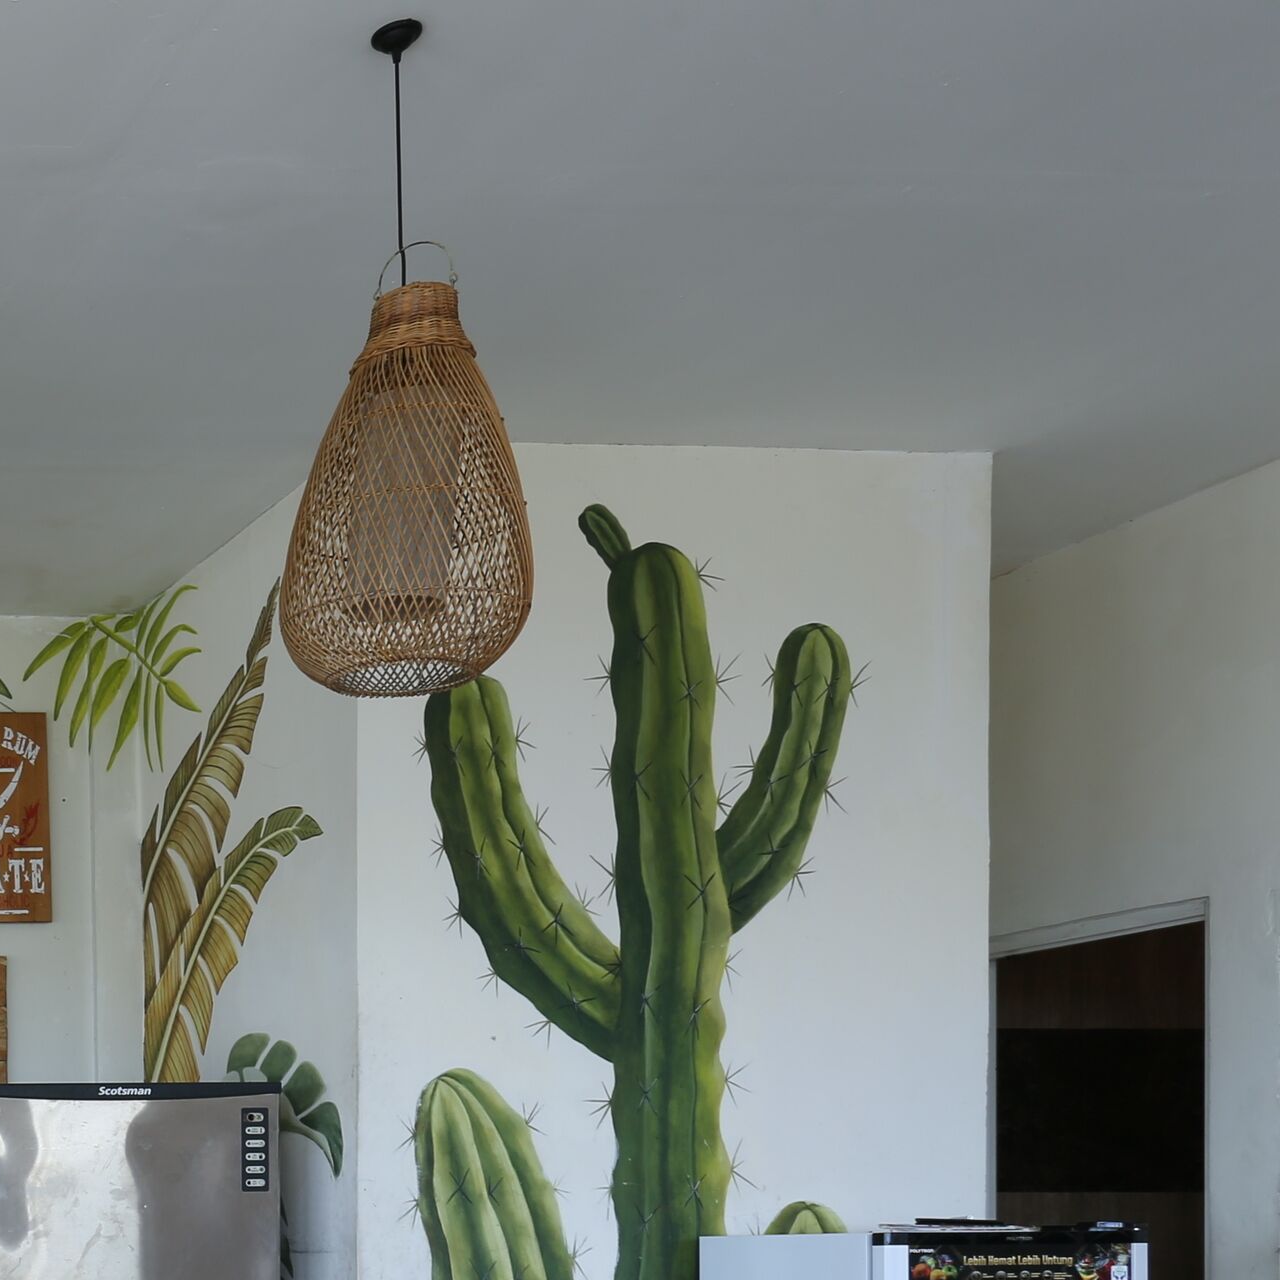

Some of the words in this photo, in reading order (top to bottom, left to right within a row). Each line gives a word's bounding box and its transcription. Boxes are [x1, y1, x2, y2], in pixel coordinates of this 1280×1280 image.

[1, 726, 40, 765] RUM
[98, 1086, 152, 1096] Scotsman
[963, 1255, 987, 1266] Lebih
[988, 1255, 1016, 1266] Hemat
[1017, 1255, 1040, 1266] Lebih
[1042, 1254, 1073, 1267] Untung
